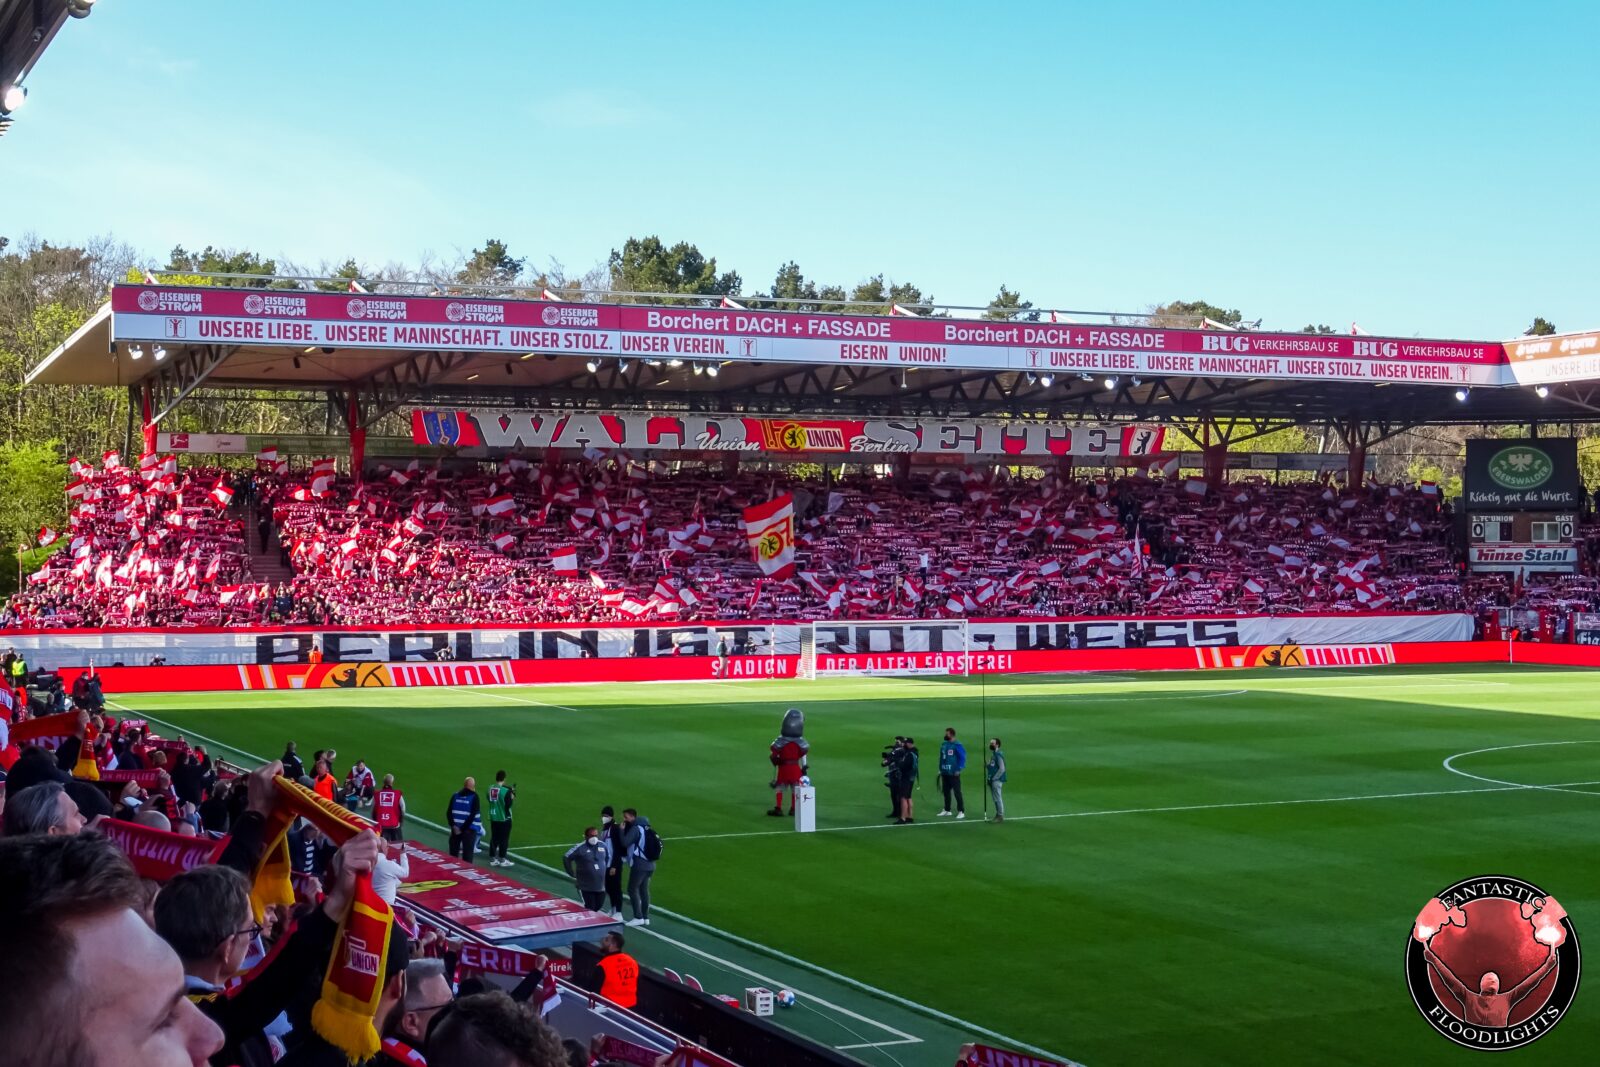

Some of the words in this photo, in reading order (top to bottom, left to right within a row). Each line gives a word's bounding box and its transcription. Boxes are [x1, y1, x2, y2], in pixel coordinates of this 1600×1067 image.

[159, 291, 202, 302] EISERNER
[264, 295, 306, 306] EISERNER
[366, 300, 406, 310] EISERNER
[465, 303, 504, 313] EISERNER
[560, 307, 598, 318] EISERNER
[647, 311, 729, 331] Borchert
[735, 316, 787, 333] DACH
[808, 319, 891, 338] FASSADE
[199, 320, 264, 339] UNSERE
[268, 322, 319, 341] LIEBE.
[325, 324, 388, 343] UNSERE
[393, 326, 504, 346] MANNSCHAFT.
[510, 330, 560, 348] UNSER
[563, 333, 613, 350] STOLZ.
[622, 335, 669, 353] UNSER
[673, 336, 730, 355] VEREIN.
[944, 324, 1018, 343] Borchert
[1024, 328, 1070, 344] DACH
[1090, 331, 1165, 348] FASSADE
[1201, 335, 1250, 351] BUG
[1252, 339, 1325, 352] VERKEHRSBAU
[1328, 341, 1339, 352] SE
[840, 343, 888, 360] EISERN
[899, 346, 946, 363] UNION!
[1352, 340, 1399, 358] BUG
[1402, 345, 1471, 358] VERKEHRSBAU
[1473, 348, 1484, 359] SE
[1050, 351, 1099, 368] UNSERE
[1101, 353, 1140, 369] LIEBE.
[1147, 355, 1194, 371] UNSERE
[1199, 357, 1282, 374] MANNSCHAFT.
[1287, 360, 1325, 375] UNSER
[1328, 361, 1366, 377] STOLZ.
[1370, 363, 1408, 378] UNSER
[1410, 364, 1453, 380] VEREIN.
[1545, 361, 1582, 377] UNSERE
[470, 412, 748, 450] WALD
[864, 419, 1122, 456] SEITE
[695, 431, 761, 451] Union
[806, 429, 845, 448] UNION
[849, 435, 910, 453] Berlin
[1491, 466, 1549, 485] EBERSWALDER
[1469, 491, 1500, 504] Richtig
[1504, 492, 1522, 504] gut
[1524, 491, 1538, 501] die
[256, 631, 599, 663] BERLIN
[352, 949, 378, 973] UNION
[617, 967, 635, 980] 122
